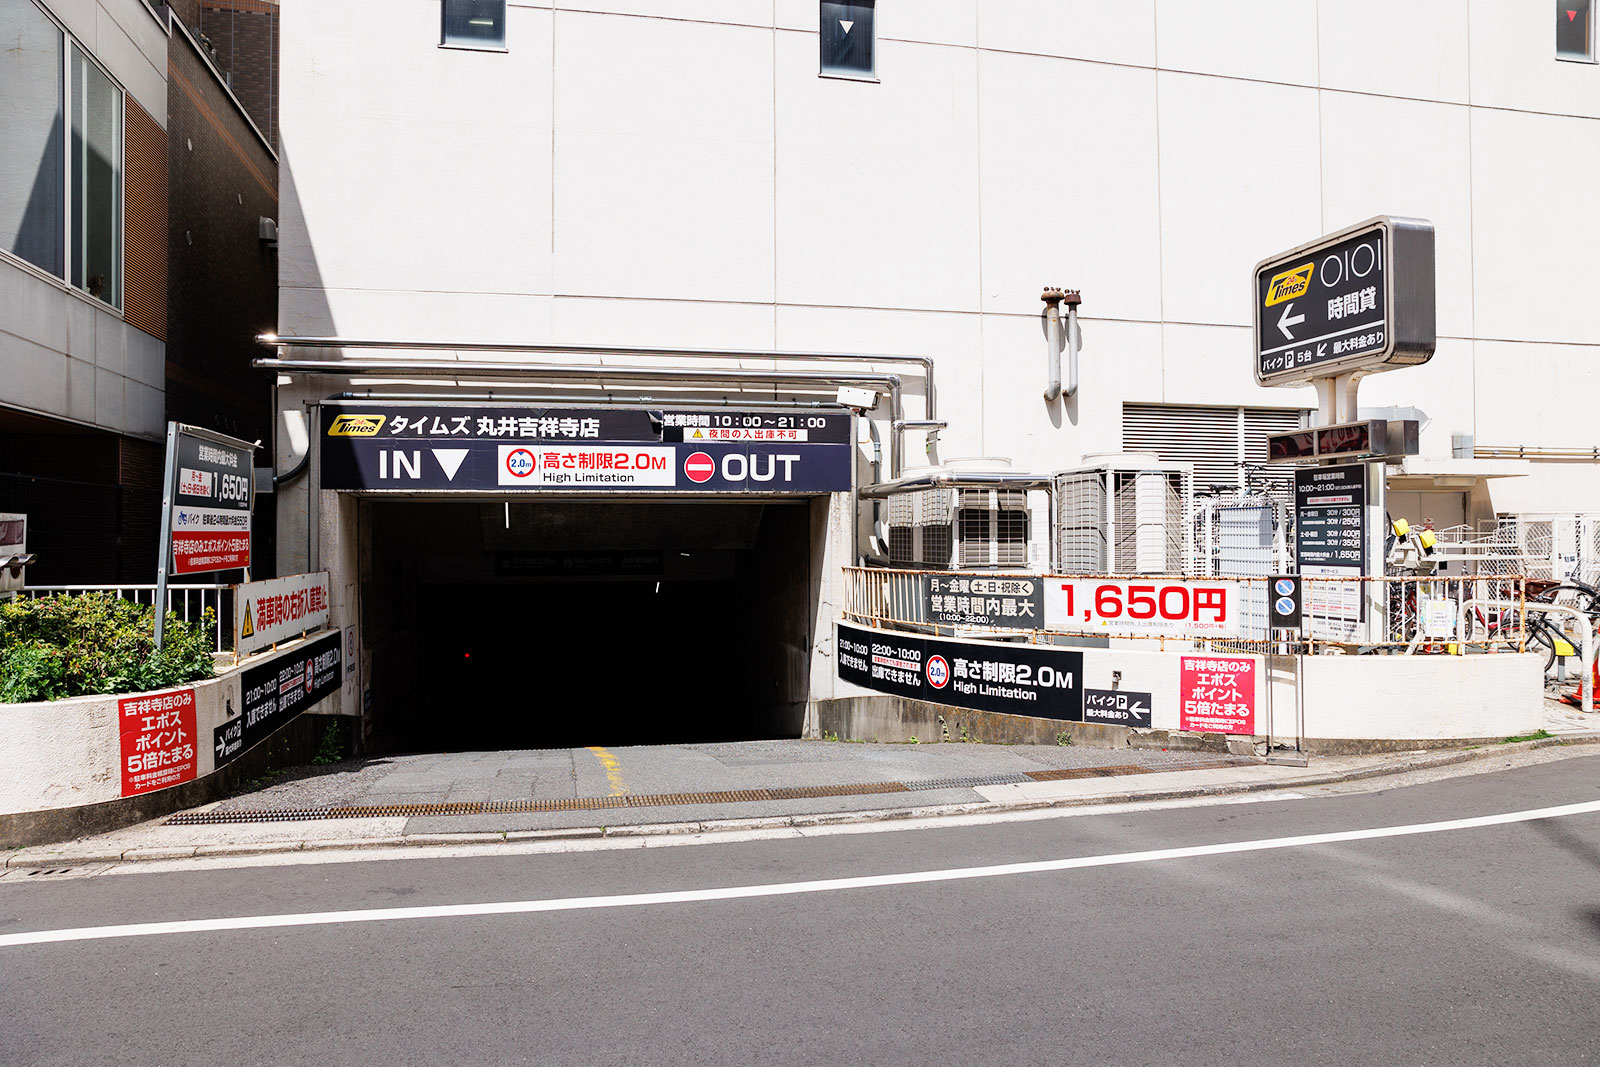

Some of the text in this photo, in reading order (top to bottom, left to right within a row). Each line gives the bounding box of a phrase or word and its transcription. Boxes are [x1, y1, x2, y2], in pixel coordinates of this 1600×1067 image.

[1272, 279, 1306, 301] Times
[1327, 286, 1377, 320] 時間貸
[1263, 356, 1283, 371] バイク
[1297, 351, 1312, 363] 5台
[1333, 331, 1384, 355] 最大料金あり
[336, 421, 376, 433] Times
[389, 415, 600, 438] タイムズ 丸井吉祥寺店
[663, 414, 710, 427] 営業時間
[708, 429, 797, 440] 夜間の入出庫不可
[379, 450, 421, 479] IN
[510, 458, 532, 468] 2.0m
[543, 452, 667, 470] 高さ制限2.0M
[721, 453, 801, 482] OUT
[213, 472, 249, 502] 1,650円
[543, 473, 634, 483] High Limitation
[256, 584, 328, 632] 満車時の右折入庫禁止
[930, 594, 1035, 618] 営業時間内最大
[1061, 584, 1227, 622] 1,650円
[871, 643, 921, 661] 22:00～10:00
[871, 664, 921, 687] 出庫できません
[930, 666, 945, 677] 2.0m
[953, 658, 1073, 689] 高さ制限2.0M
[1183, 659, 1251, 673] 吉祥寺店のみ
[953, 680, 1037, 701] High Limitation
[1196, 673, 1238, 687] エポス
[123, 693, 192, 716] 吉祥寺店のみ
[1086, 694, 1116, 707] バイク
[1191, 687, 1243, 702] ポイント
[1086, 708, 1129, 720] 最大料金あり
[1184, 700, 1250, 717] 5倍たまる
[141, 711, 182, 732] エポス
[135, 728, 187, 751] ポイント
[127, 743, 194, 773] 5倍たまる
